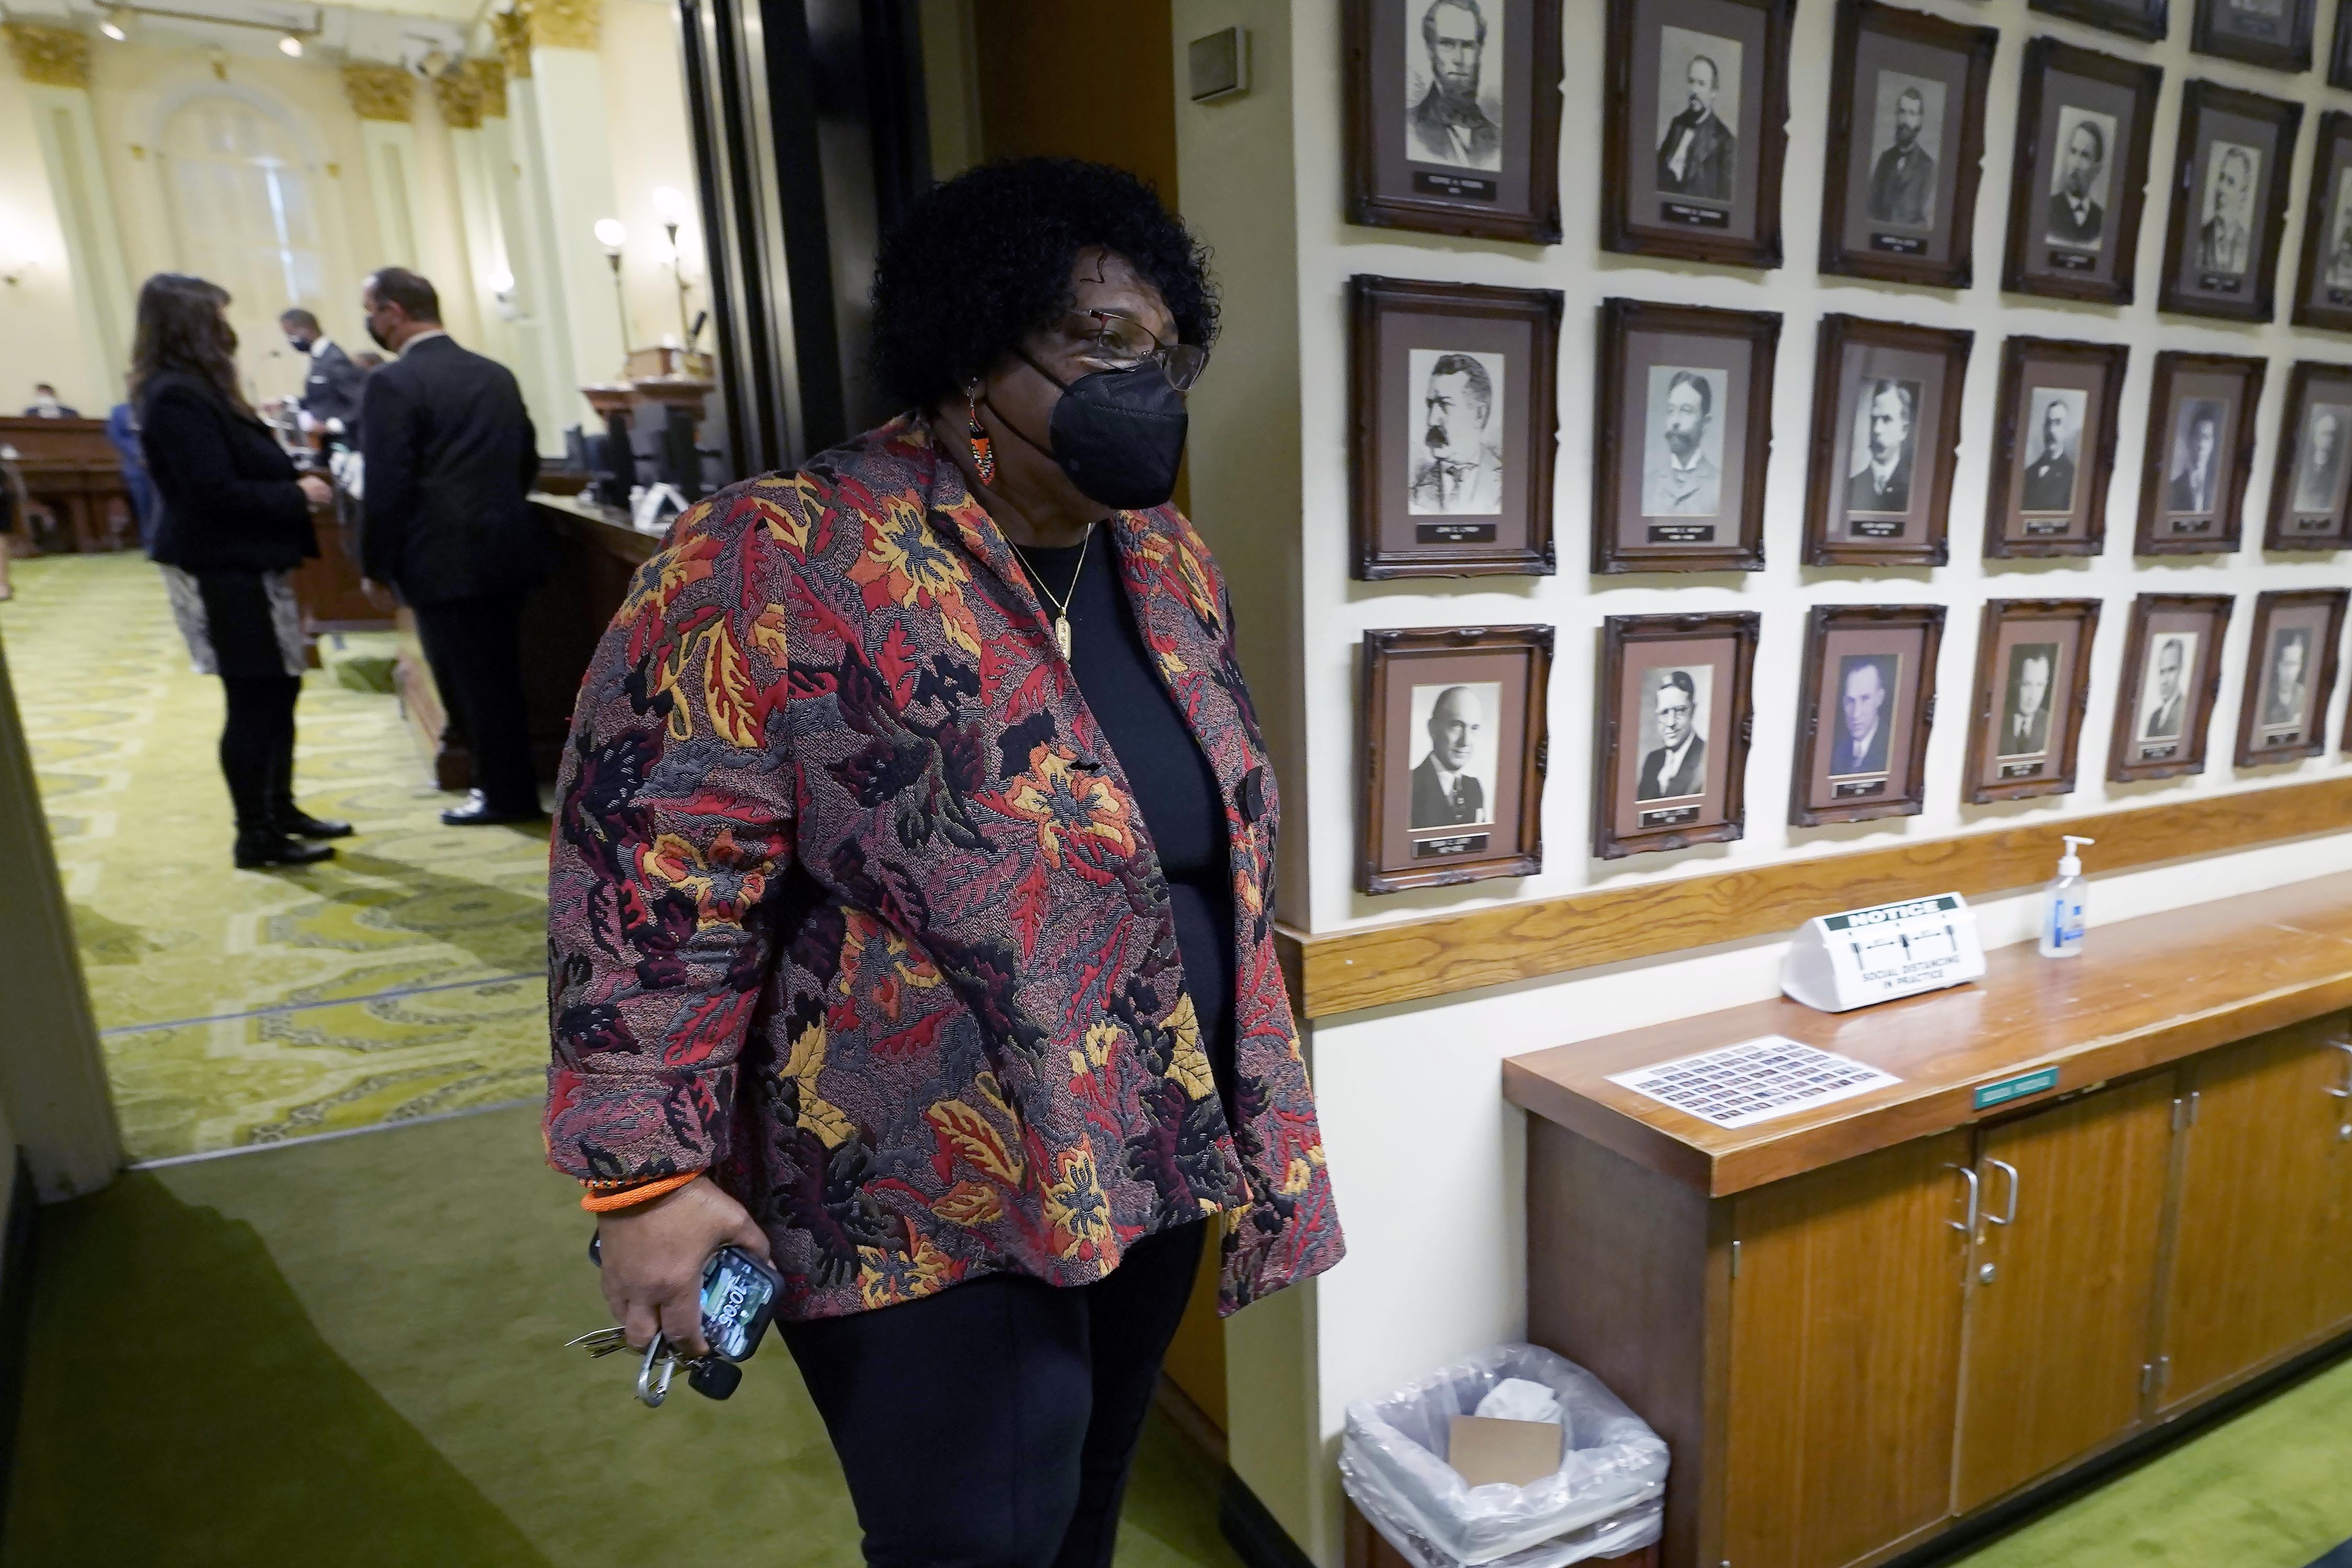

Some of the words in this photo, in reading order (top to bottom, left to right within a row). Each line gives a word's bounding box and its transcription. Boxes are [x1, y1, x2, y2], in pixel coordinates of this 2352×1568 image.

[1848, 900, 1941, 927] NOTICE
[1863, 969, 1899, 982] SOCIAL
[1903, 955, 1959, 973] DISTANCING
[1897, 969, 1944, 984] PRACTICE
[718, 1286, 747, 1328] 10:05
